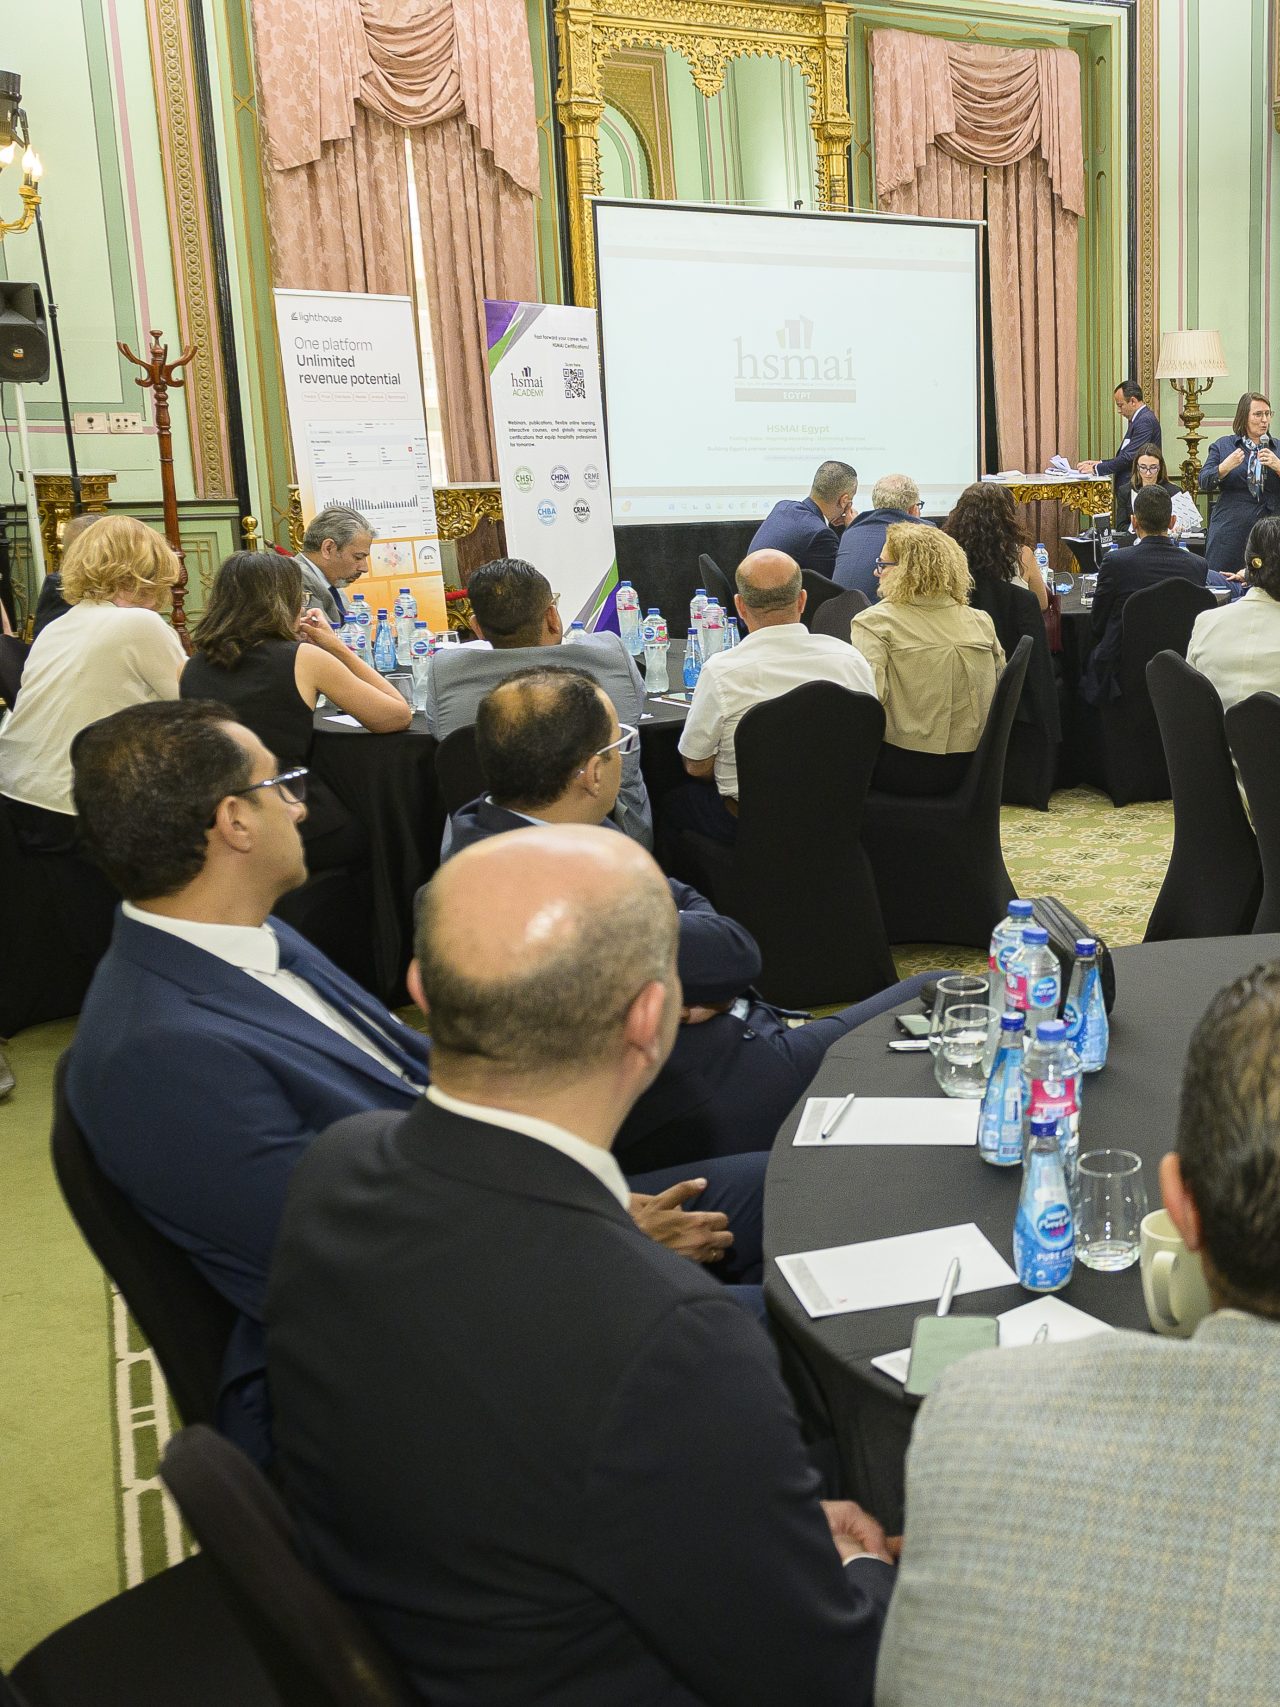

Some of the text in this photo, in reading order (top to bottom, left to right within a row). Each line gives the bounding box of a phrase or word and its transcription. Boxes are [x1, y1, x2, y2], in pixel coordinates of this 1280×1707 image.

[299, 312, 343, 324] lighthouse
[294, 336, 374, 353] One platform
[296, 353, 356, 368] Unlimited
[733, 335, 856, 381] hsmai
[299, 372, 401, 387] revenue potential
[511, 372, 544, 388] hsmai
[512, 388, 544, 397] ACADEMY
[783, 391, 812, 400] EGYPT
[767, 424, 830, 435] HSMAI Egypt
[515, 474, 534, 483] CHSL
[550, 473, 570, 481] CHDM
[537, 507, 557, 516] CHBA
[573, 506, 590, 514] CRMA
